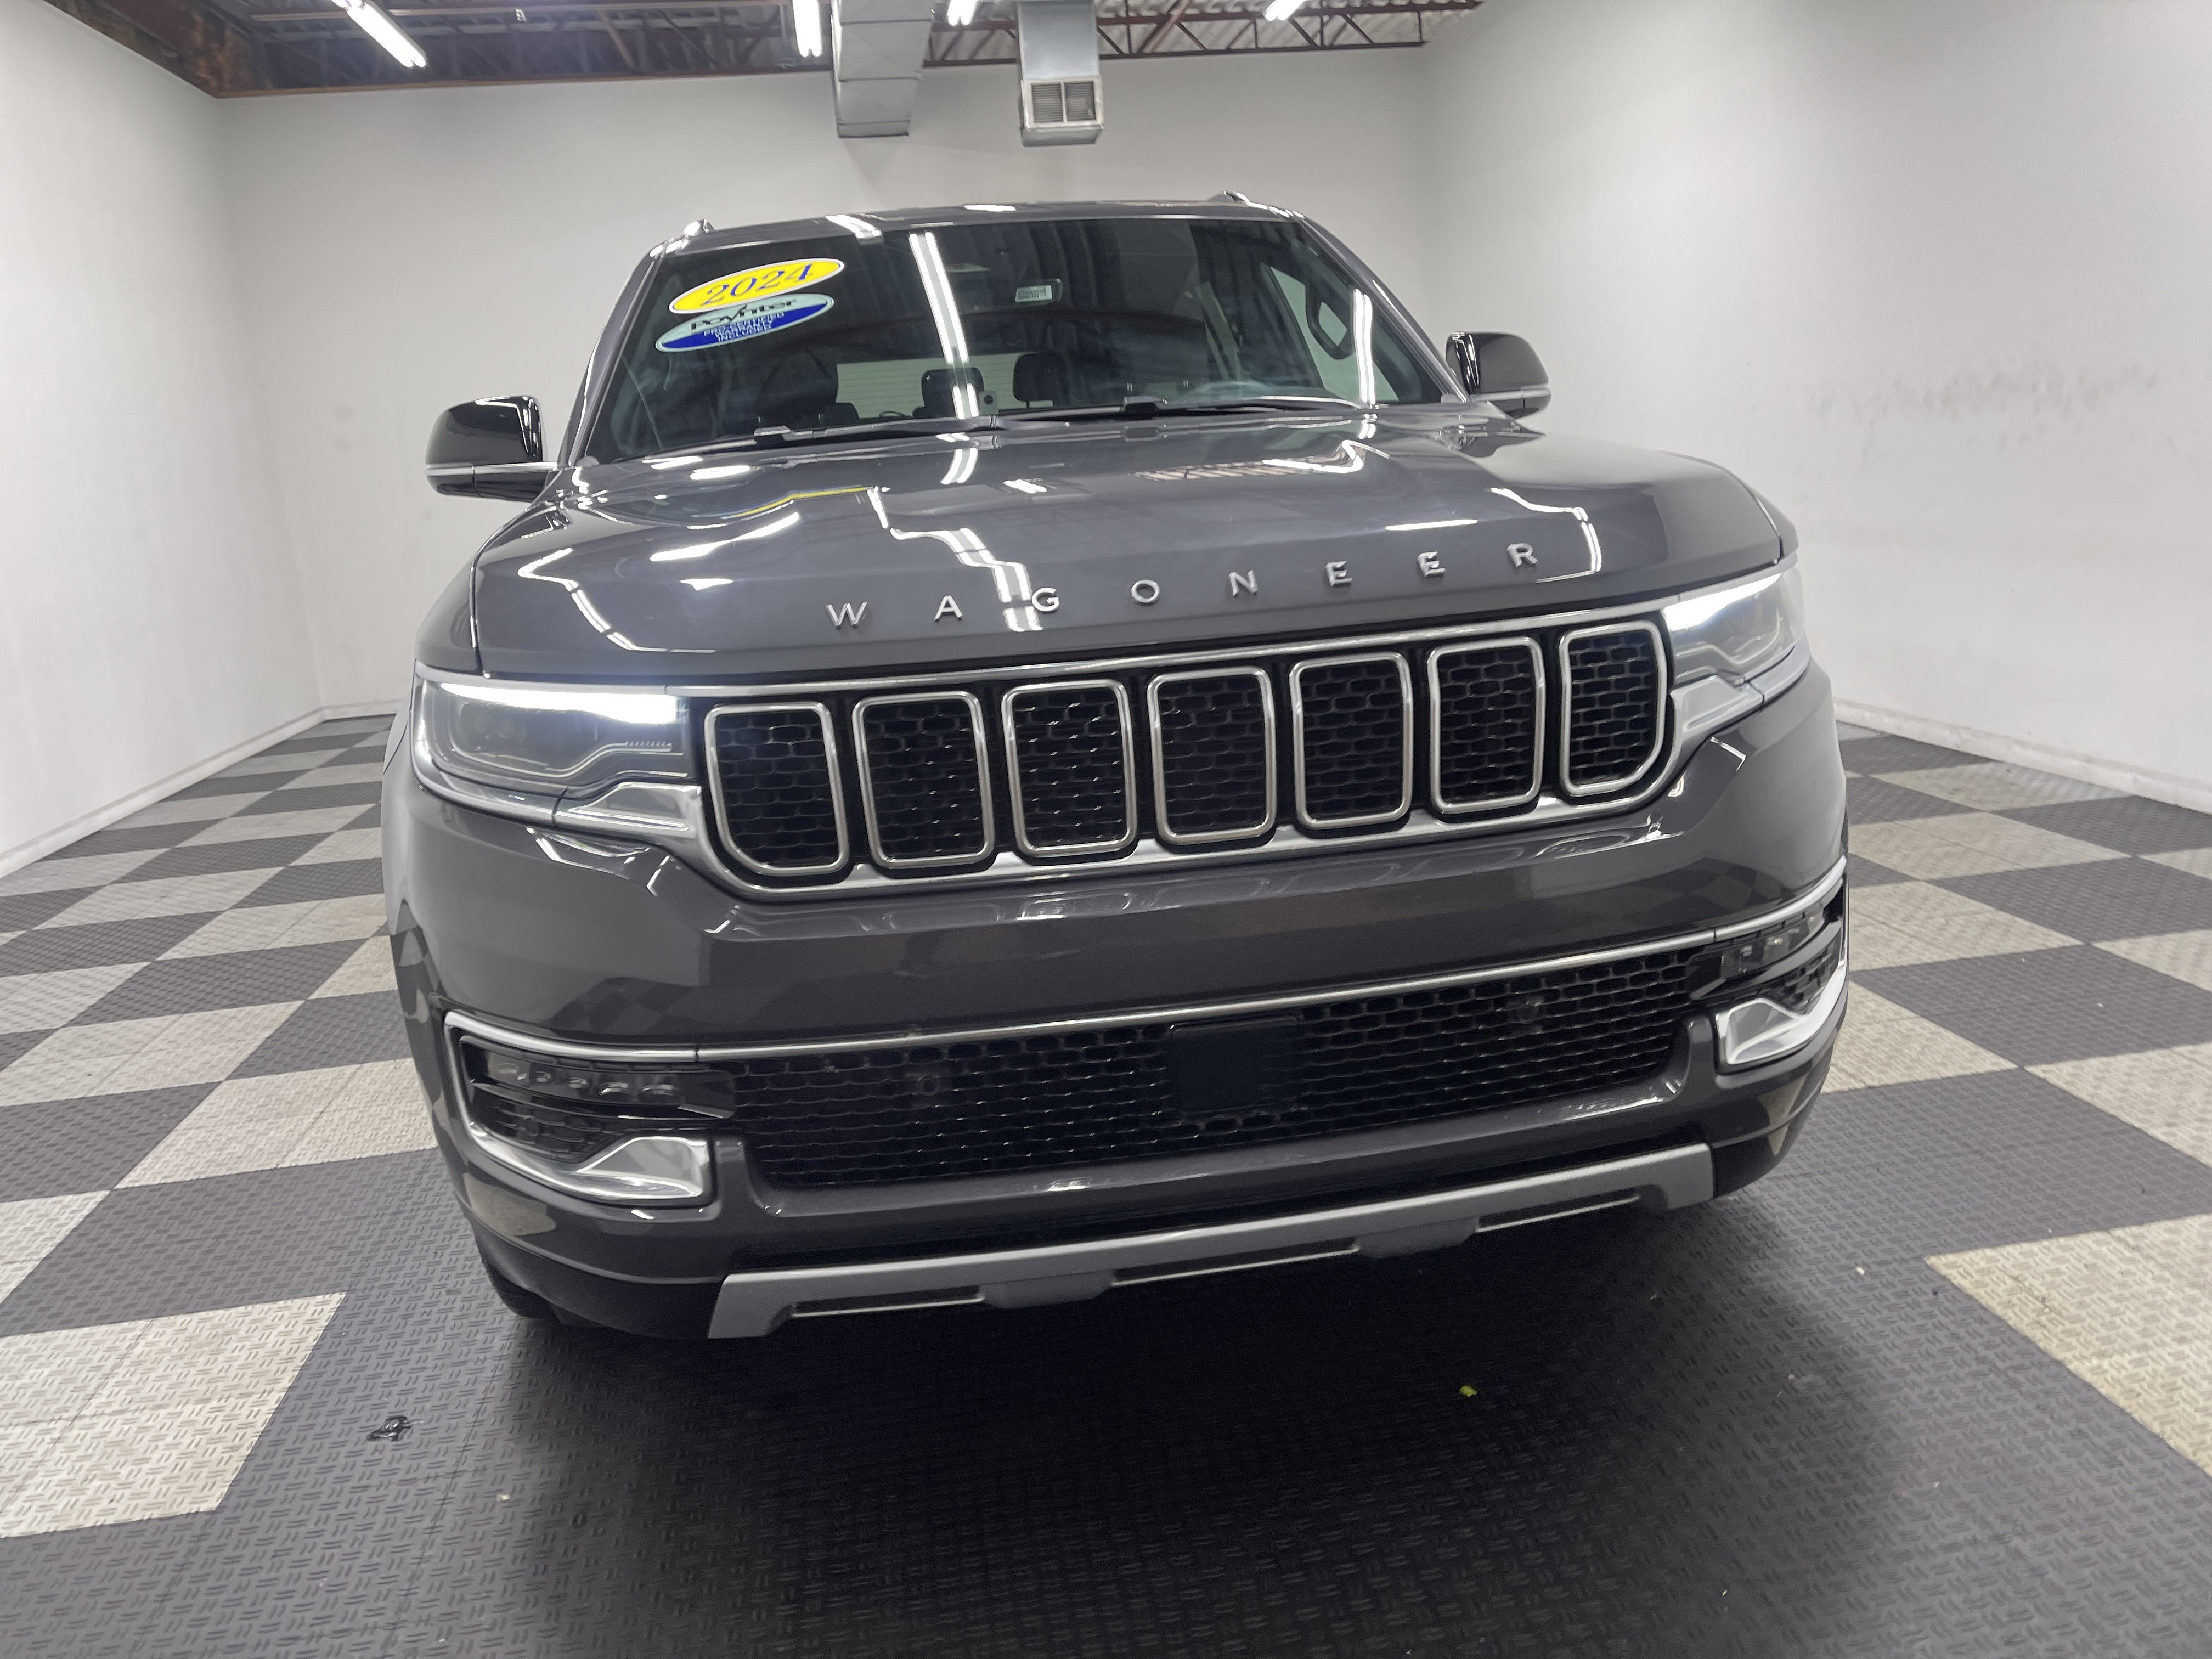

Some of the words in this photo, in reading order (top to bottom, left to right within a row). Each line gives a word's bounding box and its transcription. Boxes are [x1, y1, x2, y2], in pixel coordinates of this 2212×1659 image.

[701, 263, 813, 305] 2024
[718, 324, 771, 342] INCLUDED
[826, 543, 1538, 628] WAGONEER
